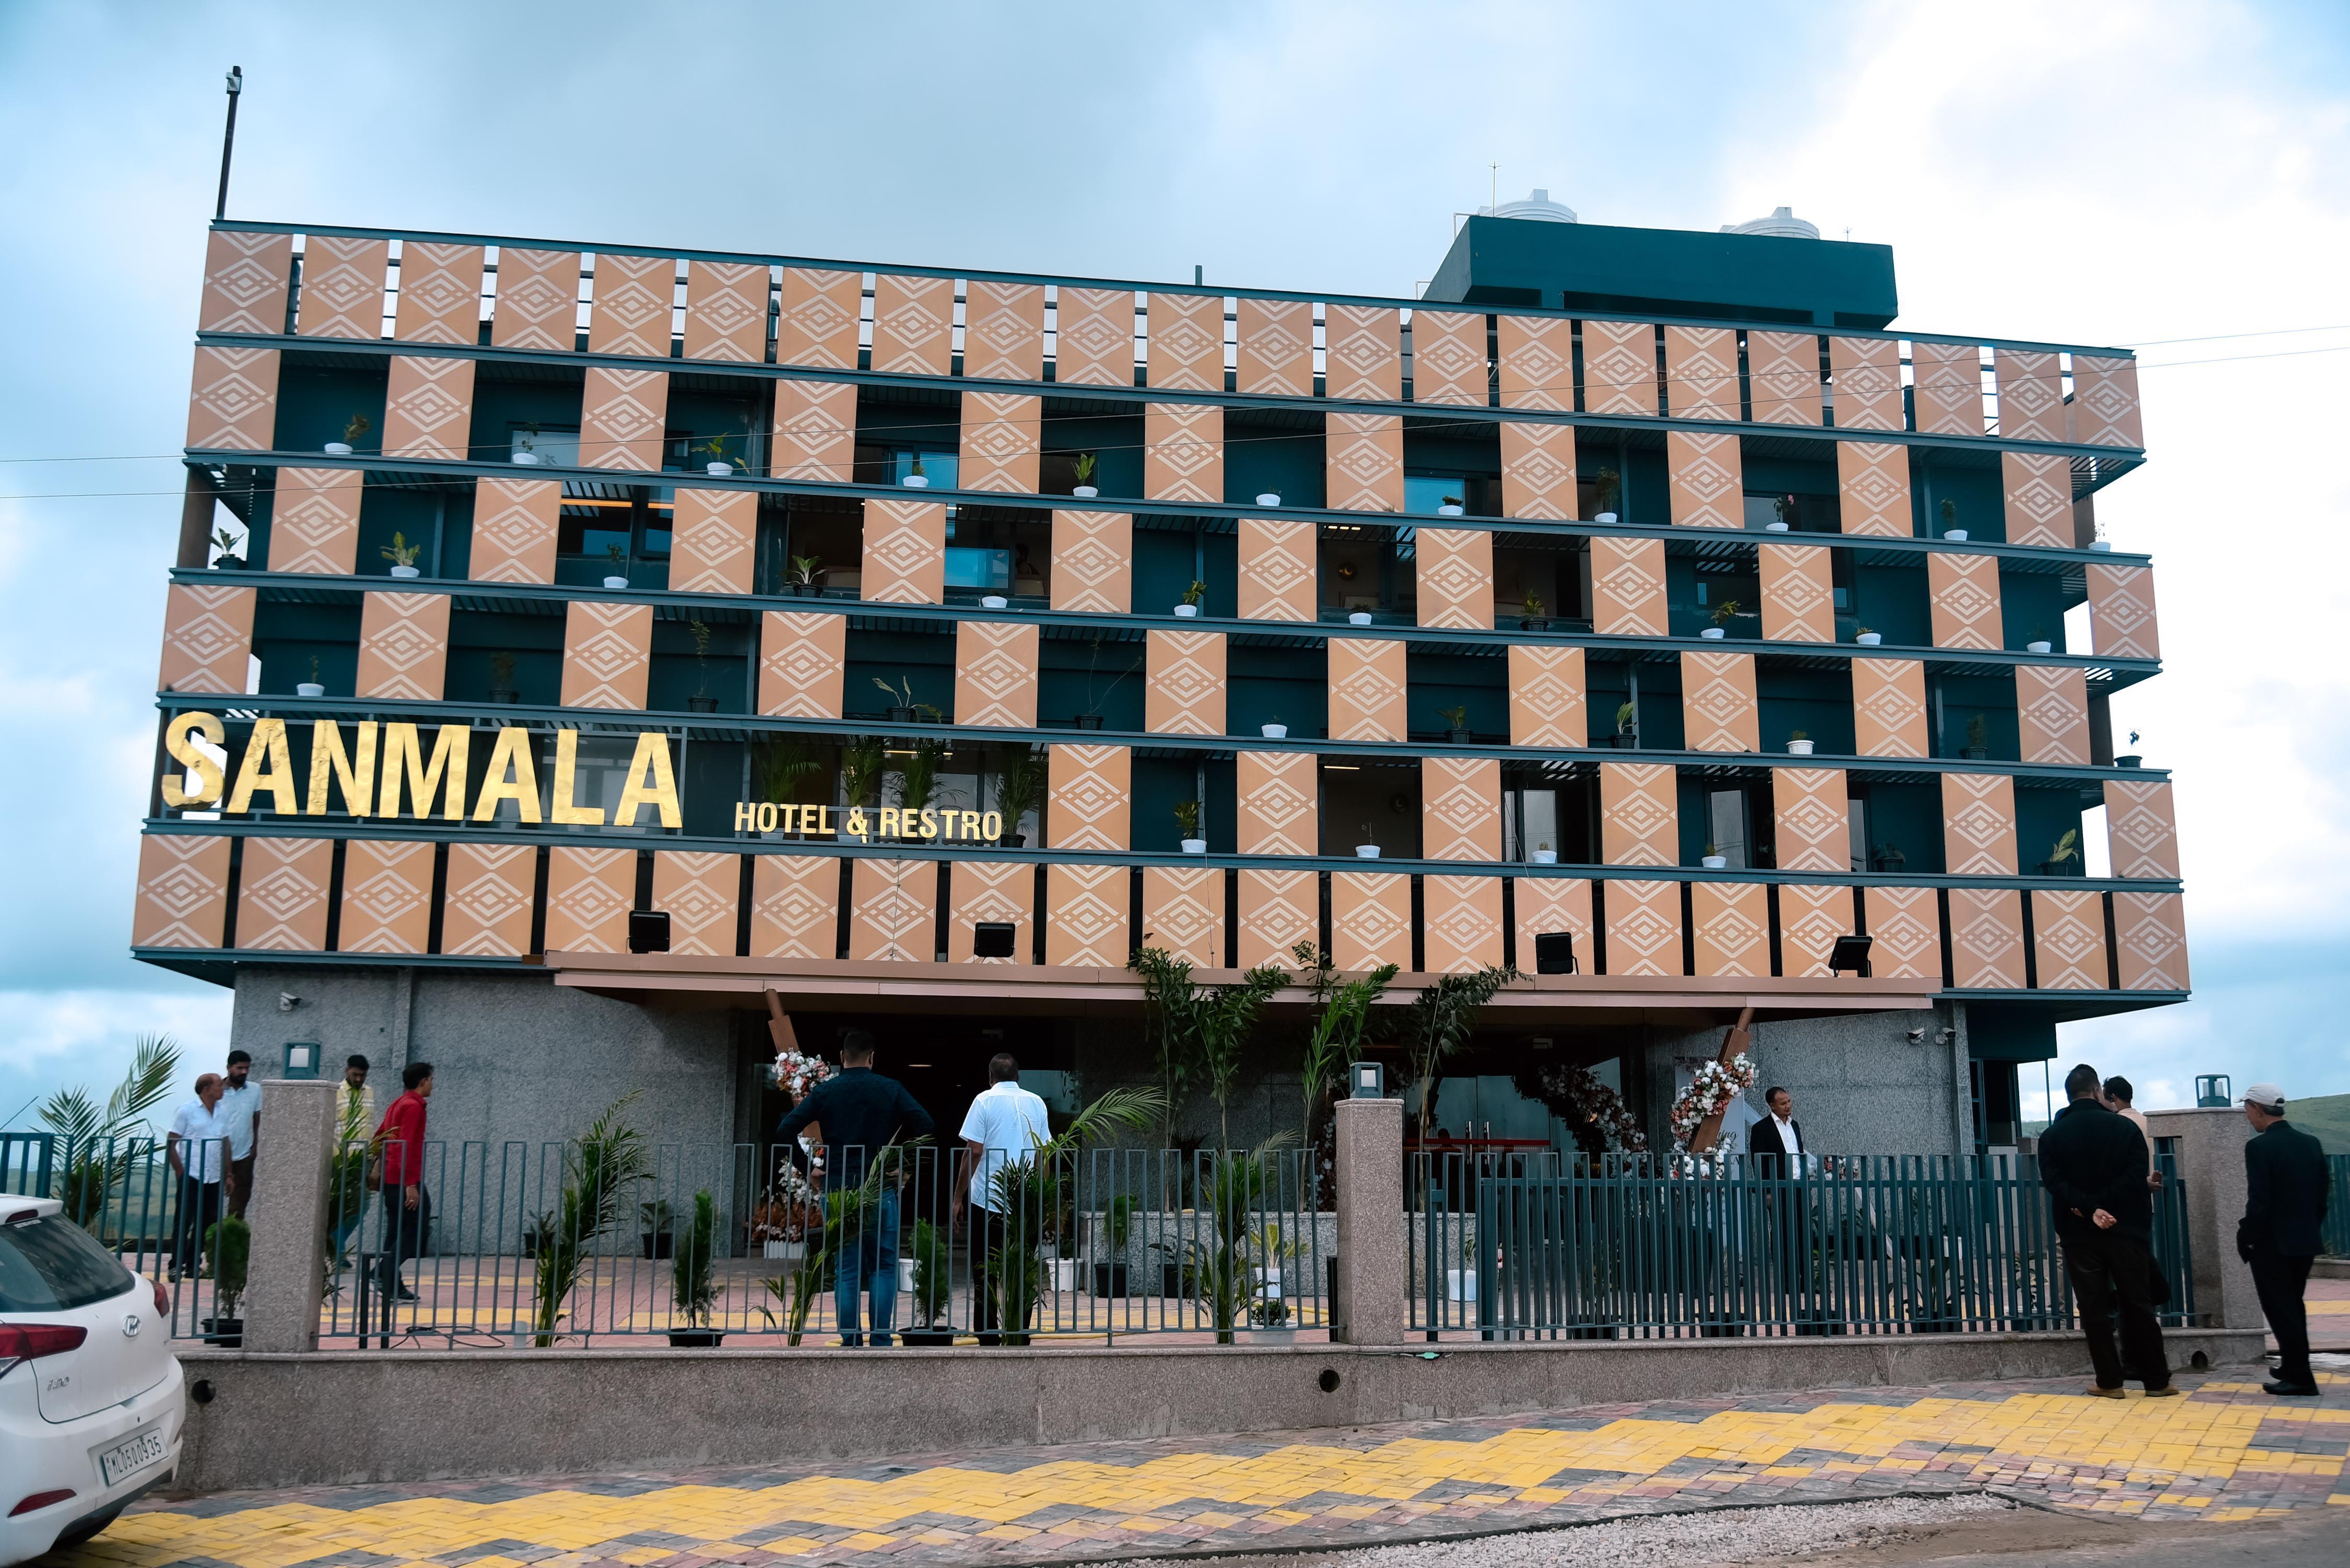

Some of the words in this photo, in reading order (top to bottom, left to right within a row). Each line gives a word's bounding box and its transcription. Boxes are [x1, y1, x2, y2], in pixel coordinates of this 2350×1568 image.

[162, 711, 683, 828] SANMALA
[735, 801, 836, 834] HOTEL
[846, 805, 868, 842] &
[879, 807, 1002, 841] RESTRO
